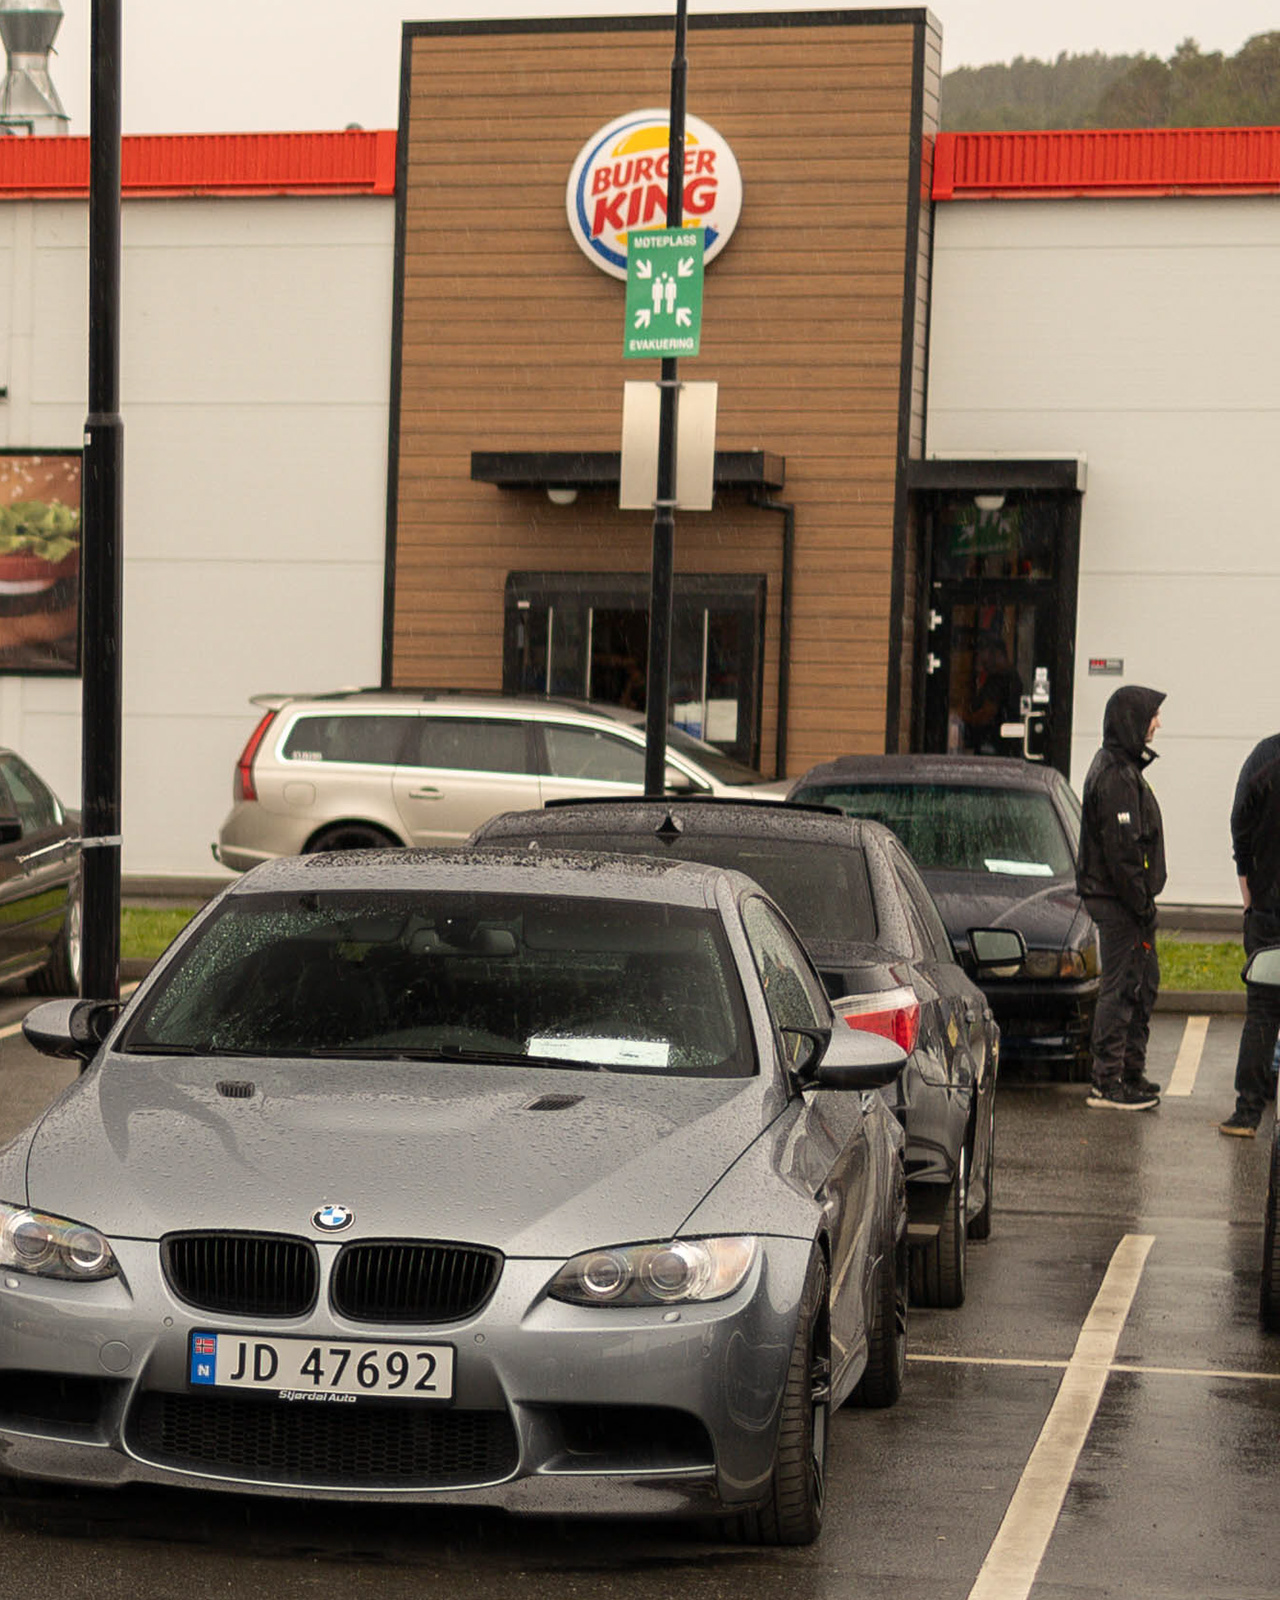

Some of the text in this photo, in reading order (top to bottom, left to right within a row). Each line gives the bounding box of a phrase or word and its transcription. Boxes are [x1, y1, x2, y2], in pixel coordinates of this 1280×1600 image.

[629, 337, 695, 351] EVAKUERING
[197, 1364, 210, 1377] N
[230, 1342, 437, 1391] JD 47692
[278, 1389, 357, 1403] Stjørdal Auto
